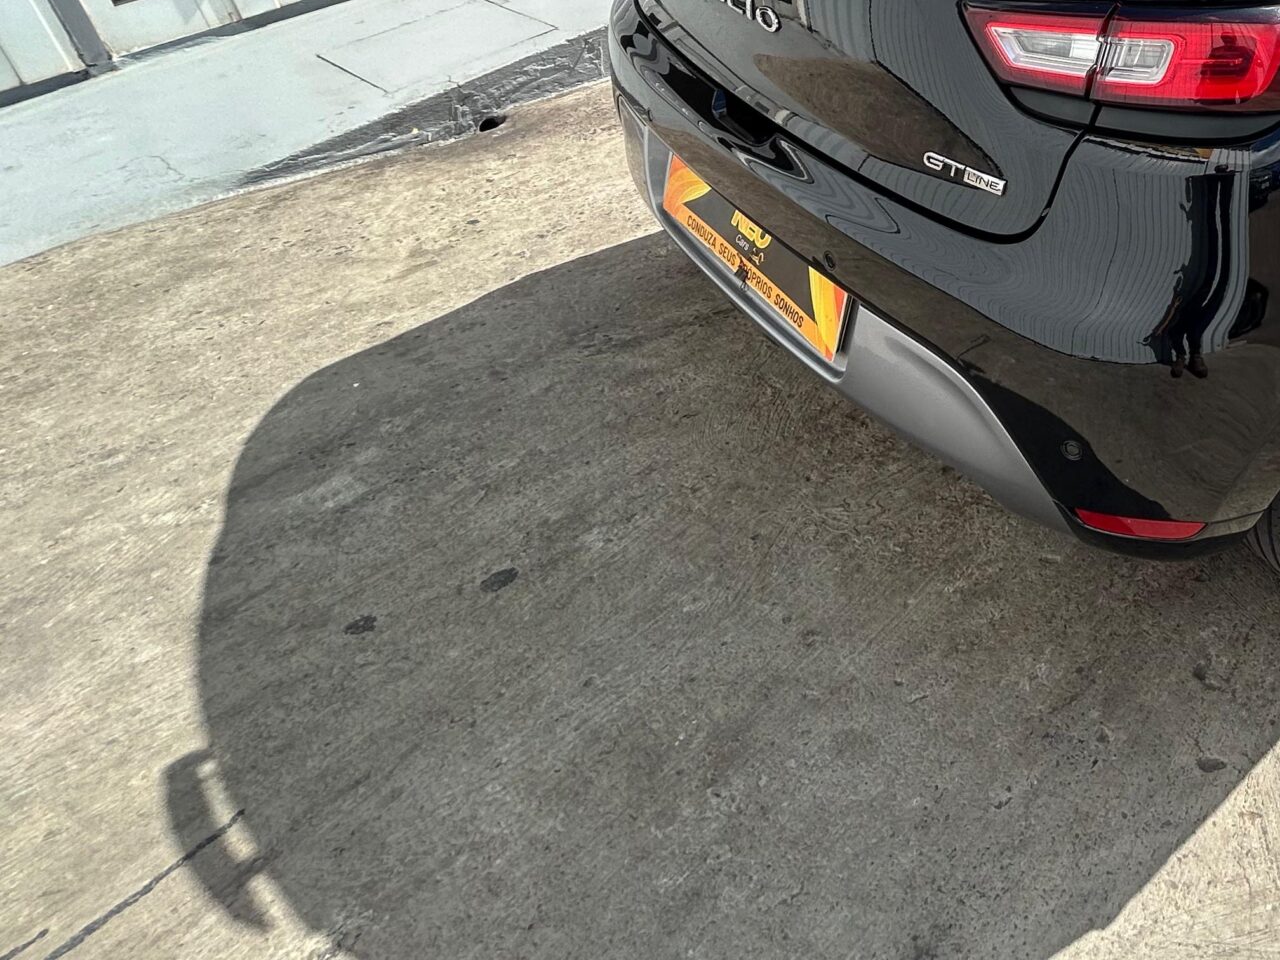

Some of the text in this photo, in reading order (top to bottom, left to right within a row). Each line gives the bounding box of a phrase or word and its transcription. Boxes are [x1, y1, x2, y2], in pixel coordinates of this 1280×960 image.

[923, 152, 1002, 192] GT LINE
[735, 234, 750, 251] Cars
[687, 215, 717, 248] CONDUZA
[718, 242, 737, 266] SEUS
[773, 294, 804, 329] SONHOS
